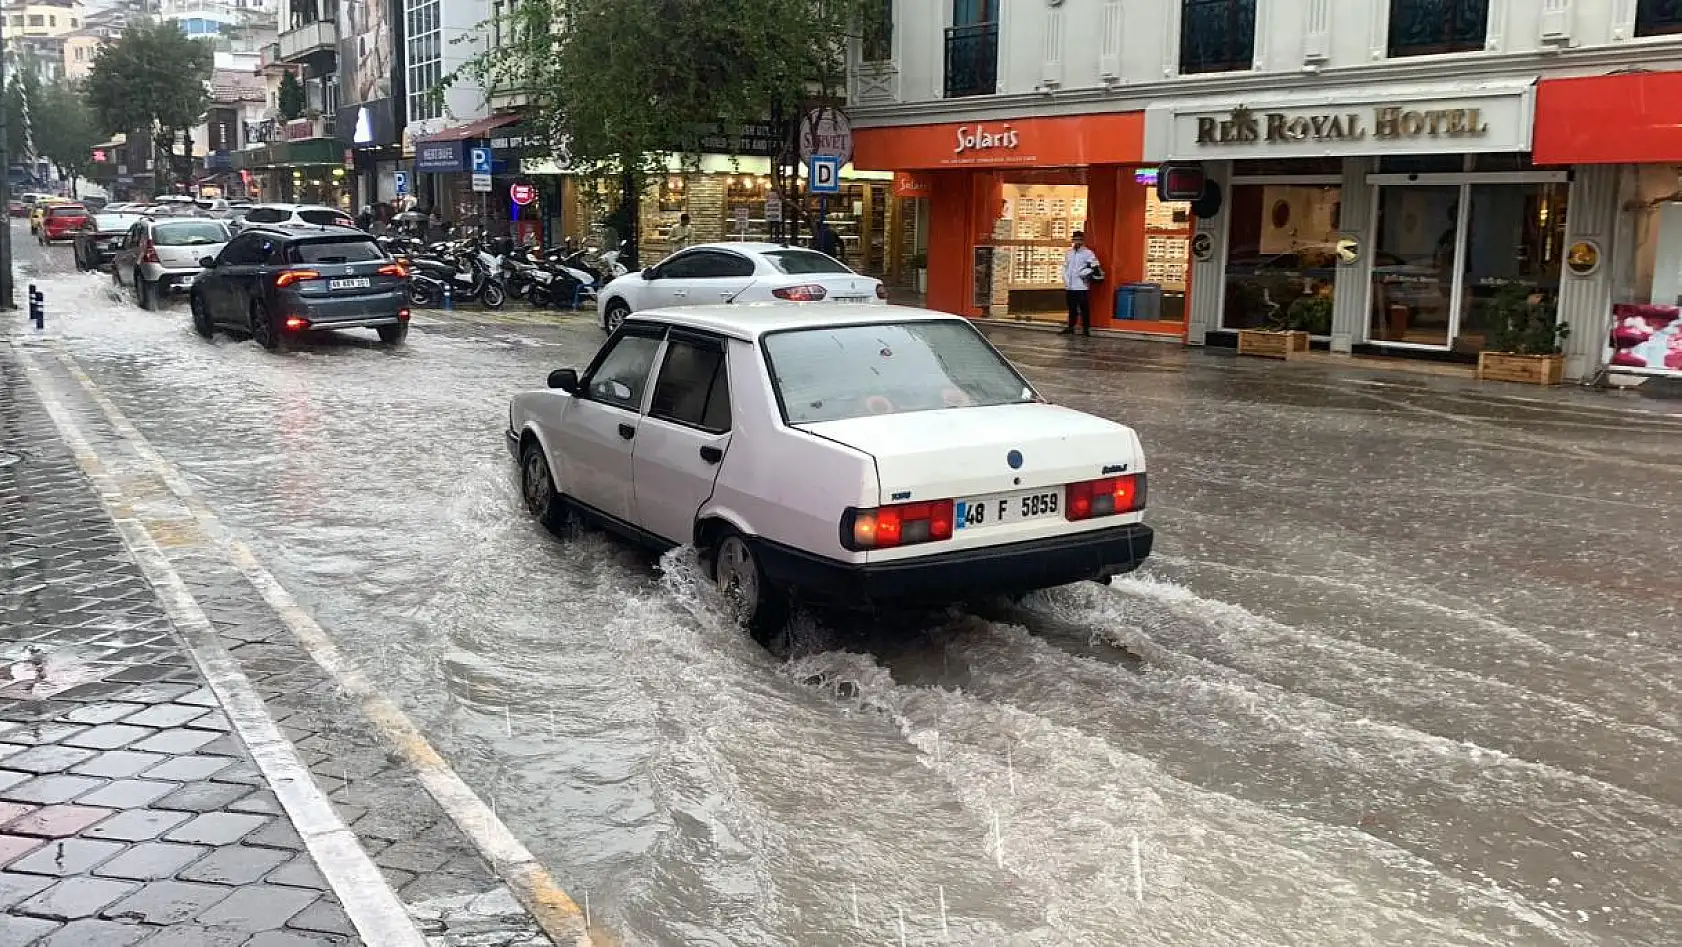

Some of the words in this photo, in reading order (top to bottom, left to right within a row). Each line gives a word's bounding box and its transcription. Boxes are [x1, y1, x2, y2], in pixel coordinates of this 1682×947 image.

[1264, 112, 1366, 141] ROYAL
[1373, 106, 1488, 137] HOTEL
[953, 123, 1018, 153] Solaris
[473, 150, 486, 171] P
[818, 163, 831, 183] D
[396, 173, 404, 192] P
[966, 503, 985, 525] 48
[998, 500, 1008, 520] F
[1021, 492, 1059, 517] 5859
